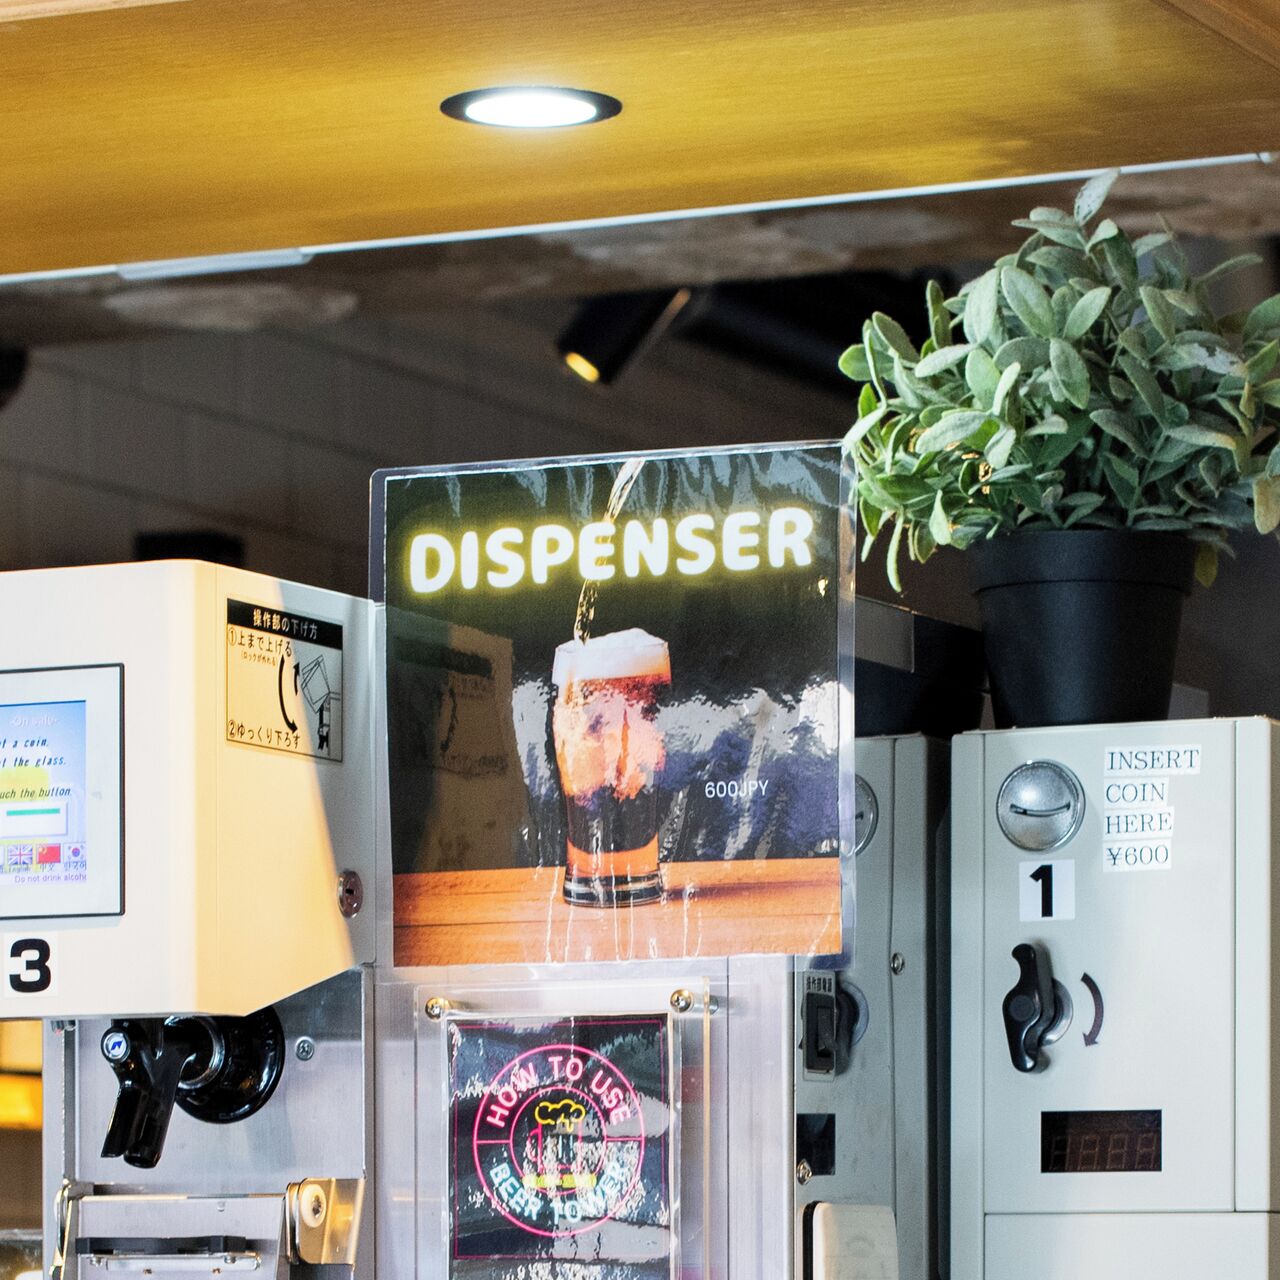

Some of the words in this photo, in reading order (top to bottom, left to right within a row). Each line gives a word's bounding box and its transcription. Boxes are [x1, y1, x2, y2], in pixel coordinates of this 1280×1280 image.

[409, 506, 814, 594] DISPENSER
[253, 609, 318, 640] 操作部の下げ方
[13, 755, 30, 767] the
[1108, 748, 1200, 771] INSERT
[20, 787, 36, 799] the
[704, 779, 770, 799] 600JPY
[1105, 781, 1166, 803] COIN
[1104, 812, 1174, 836] HERE
[1106, 846, 1170, 868] ¥600
[14, 874, 25, 884] Do
[27, 873, 41, 883] not
[42, 872, 61, 883] drink
[1028, 863, 1055, 918] 1
[9, 939, 52, 994] 3
[487, 1063, 539, 1128] HOW
[548, 1055, 584, 1081] TO
[591, 1070, 631, 1126] USE
[490, 1162, 542, 1221] BEER
